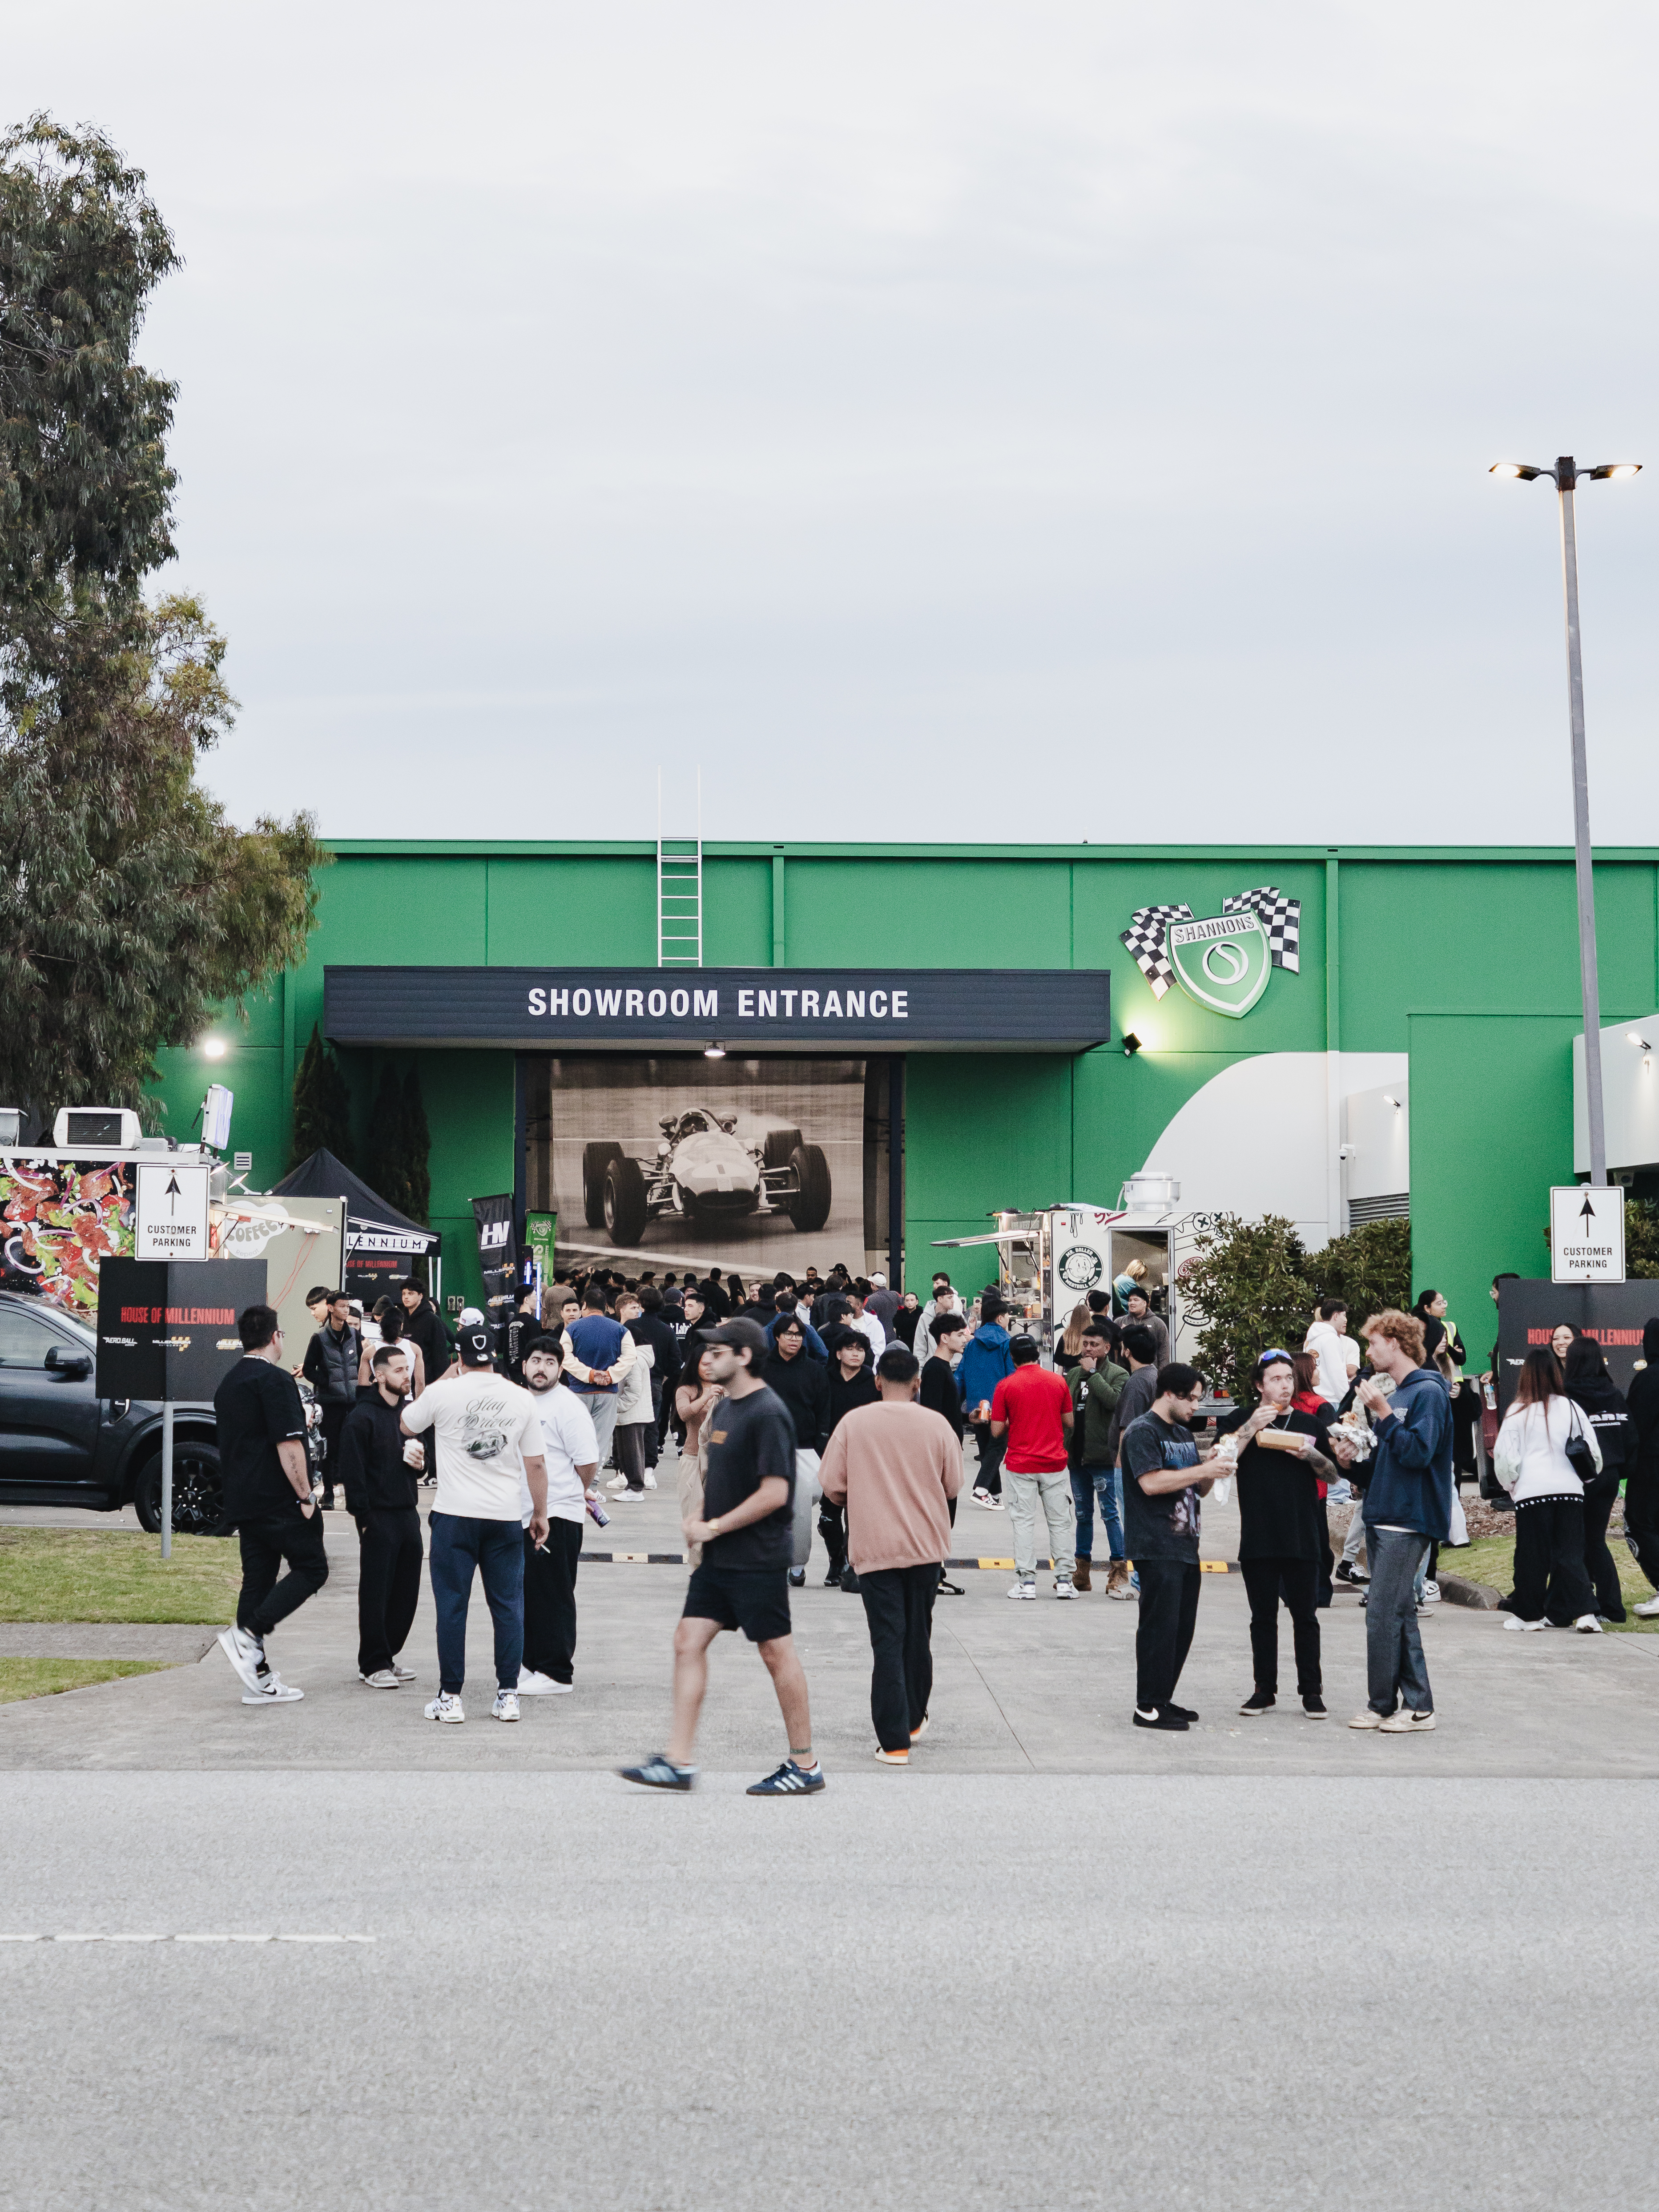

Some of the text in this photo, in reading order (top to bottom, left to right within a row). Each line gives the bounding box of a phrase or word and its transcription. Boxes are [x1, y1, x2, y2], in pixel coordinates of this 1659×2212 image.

[1174, 915, 1255, 943] SHANNONS
[527, 988, 909, 1018] SHOWROOM ENTRANCE
[148, 1225, 197, 1234] CUSTOMER
[226, 1220, 278, 1242] COFFEE
[153, 1238, 191, 1247] PARKING
[235, 1248, 260, 1257] Repeat
[1065, 1247, 1093, 1257] MR. BALLER
[1563, 1247, 1612, 1256] CUSTOMER
[1569, 1260, 1607, 1268] PARKING
[1065, 1279, 1089, 1289] MEATBALL
[121, 1307, 235, 1325] HOUSE OF MILLENNIUM
[466, 1396, 508, 1418] Stay
[454, 1413, 517, 1430] Driven
